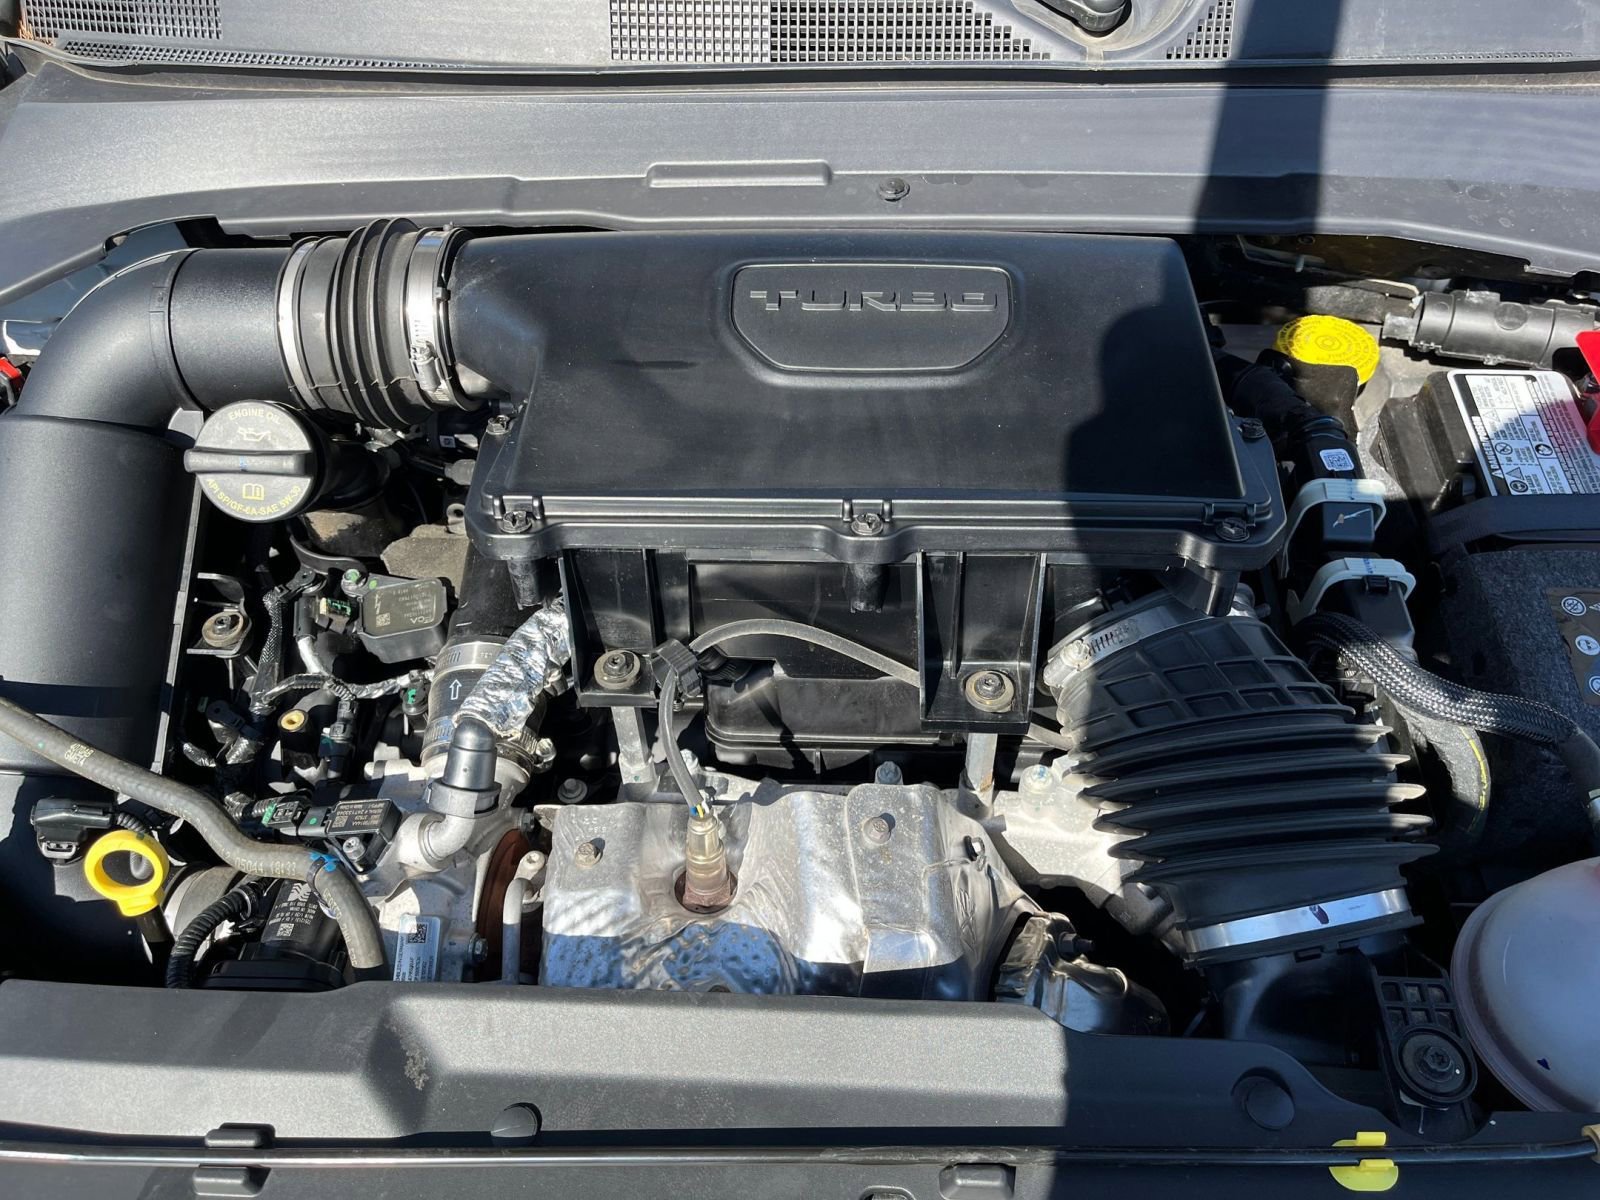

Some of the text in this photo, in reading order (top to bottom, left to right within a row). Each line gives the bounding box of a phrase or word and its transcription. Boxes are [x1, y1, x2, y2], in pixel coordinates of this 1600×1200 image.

[750, 289, 998, 312] TURBO
[228, 408, 281, 424] ENGINE OIL
